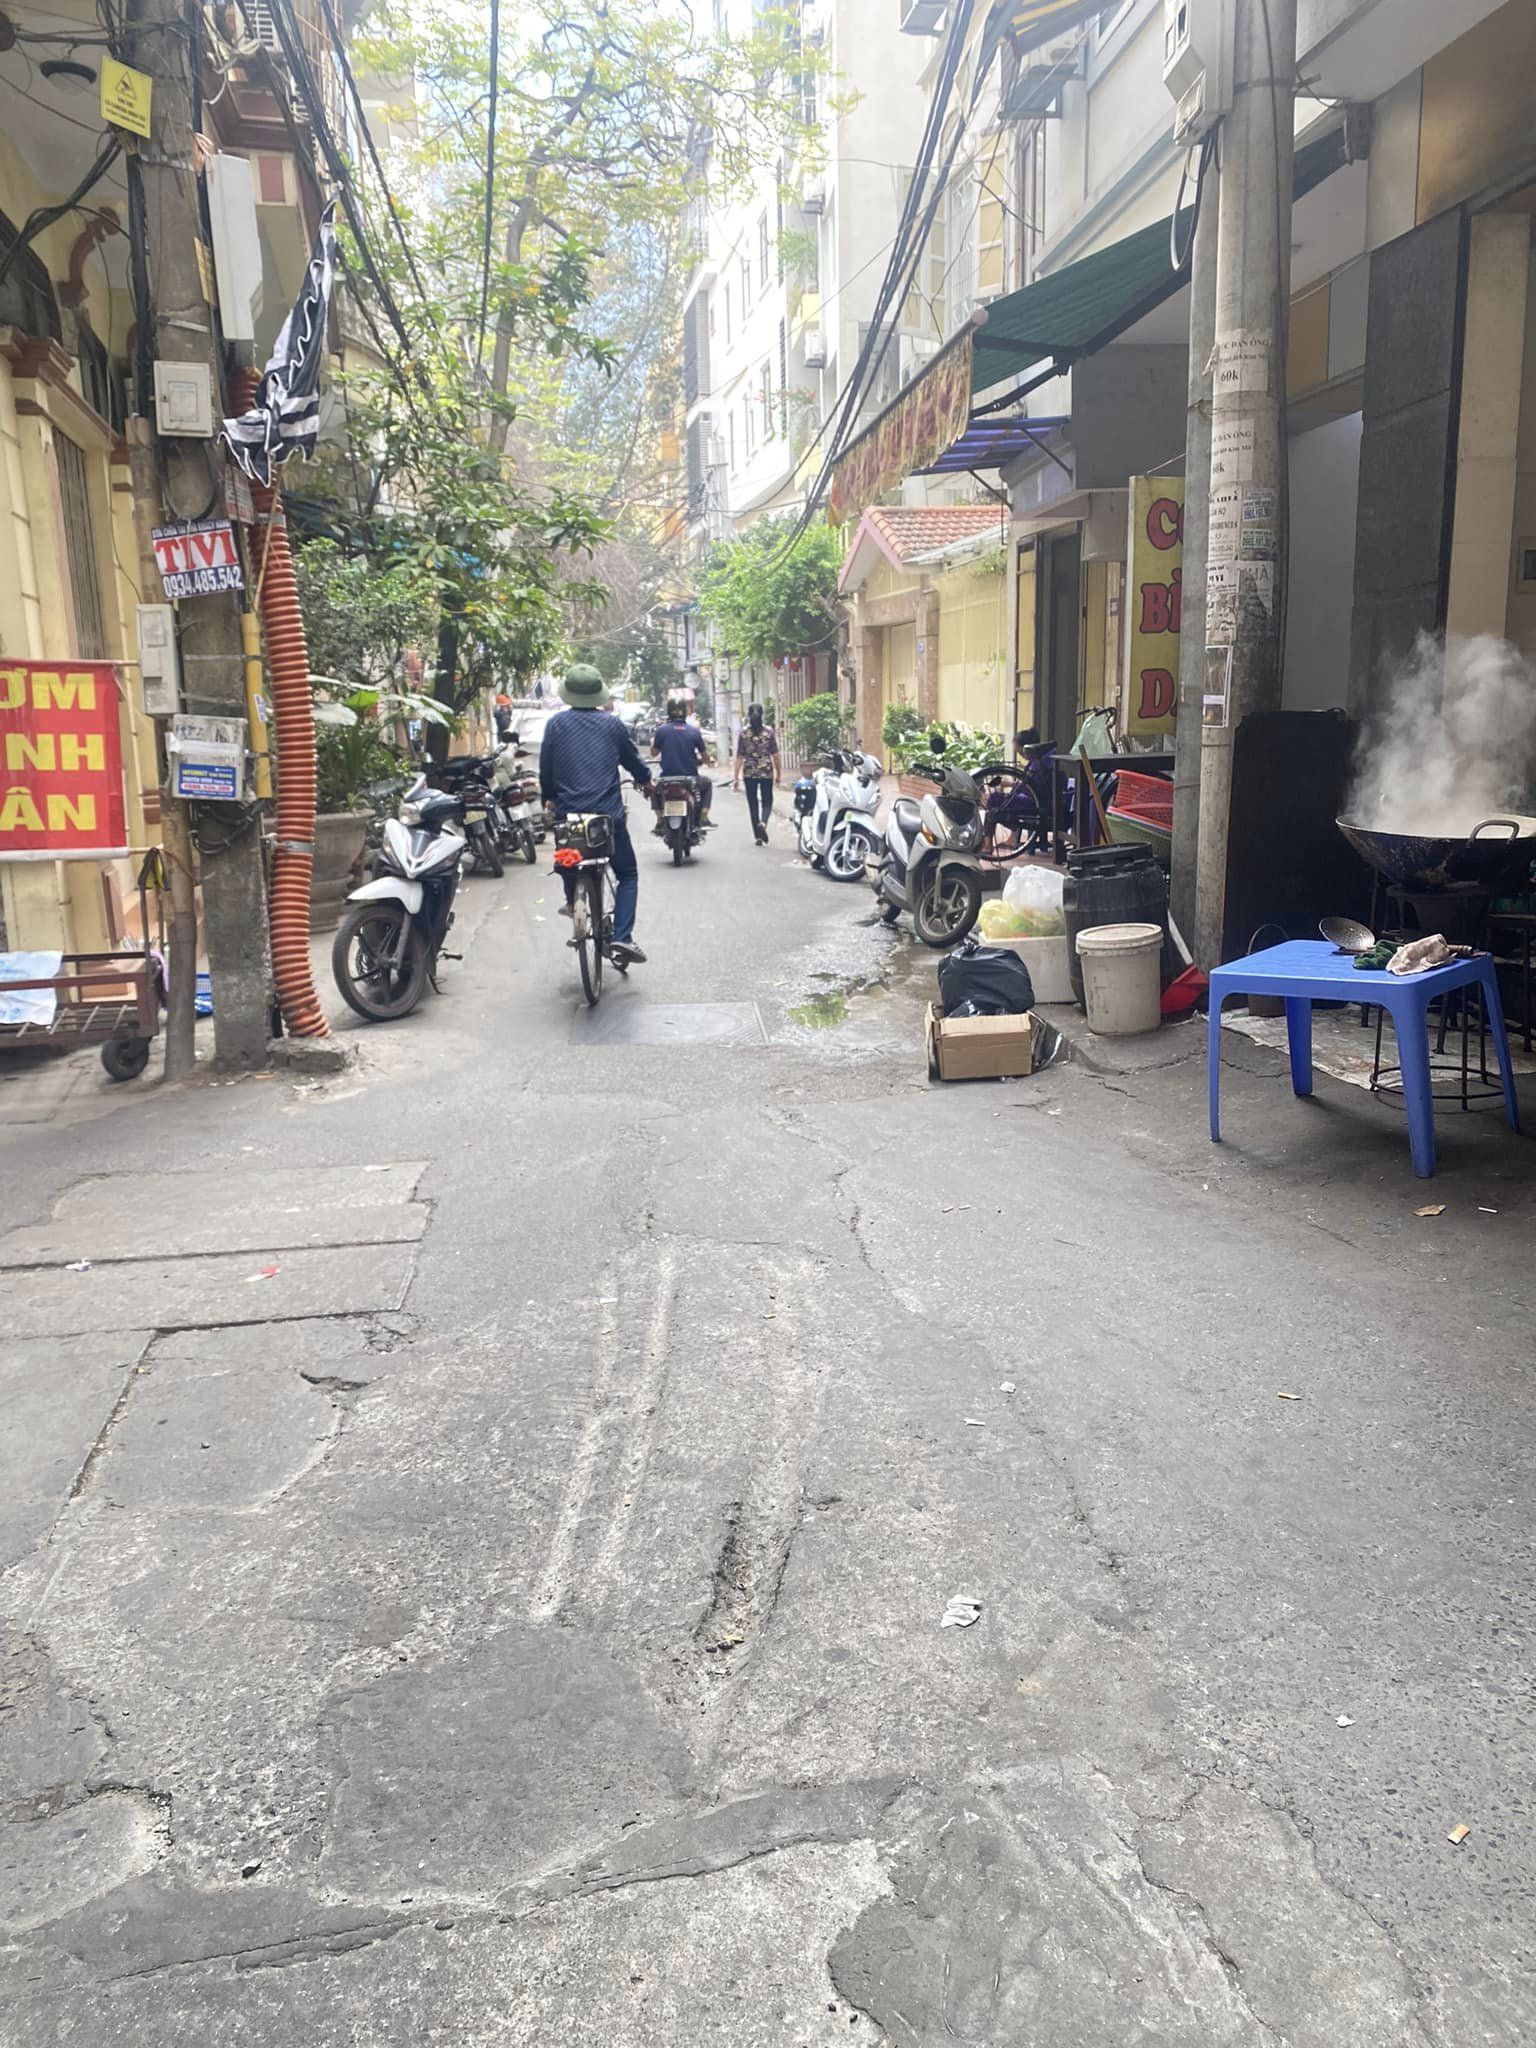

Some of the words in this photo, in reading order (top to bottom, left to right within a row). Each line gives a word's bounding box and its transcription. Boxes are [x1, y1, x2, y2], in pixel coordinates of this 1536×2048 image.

[1221, 369, 1239, 382] 60k
[156, 530, 239, 573] TIVI
[163, 565, 243, 598] 0934.485.542
